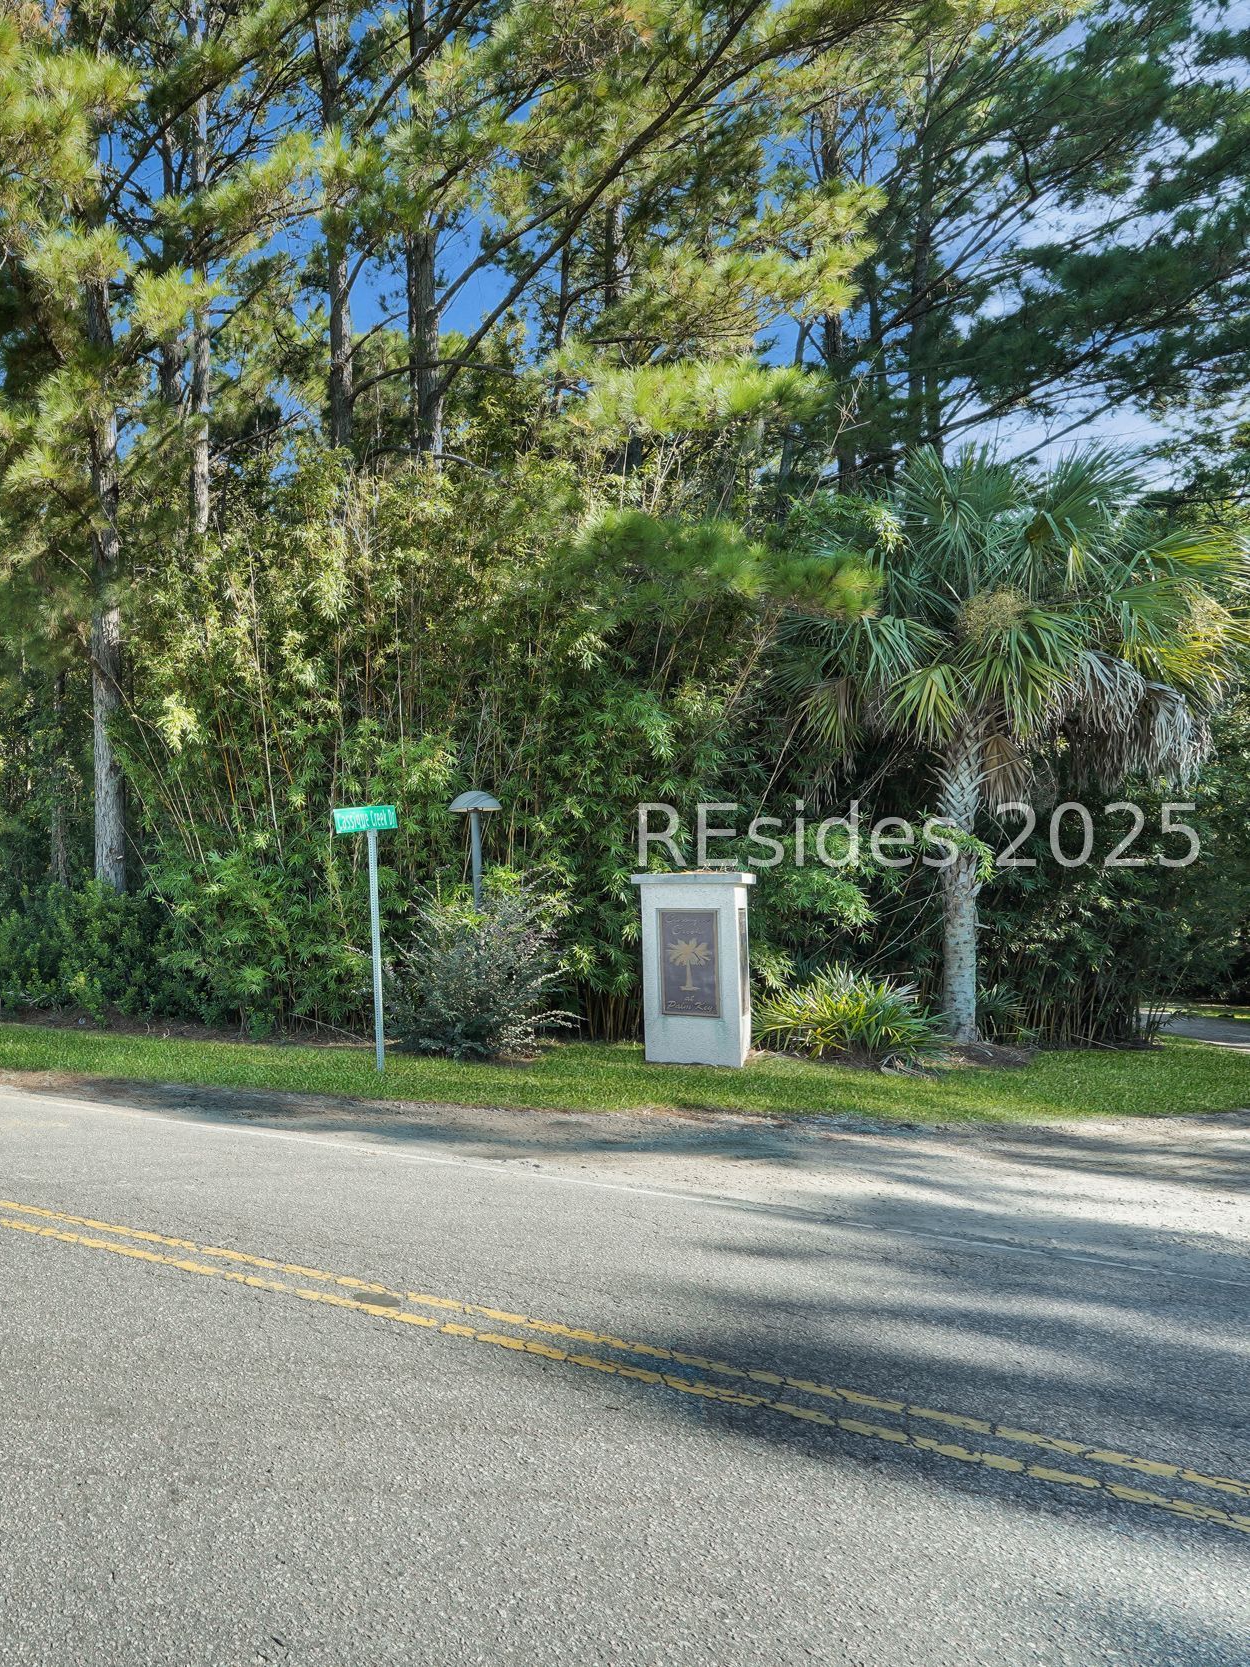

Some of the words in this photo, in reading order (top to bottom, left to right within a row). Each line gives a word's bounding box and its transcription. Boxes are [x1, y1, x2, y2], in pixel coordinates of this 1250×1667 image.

[336, 812, 370, 829] Cassique
[370, 809, 387, 826] Creek
[667, 1000, 693, 1010] Palm
[694, 1001, 713, 1012] Key
